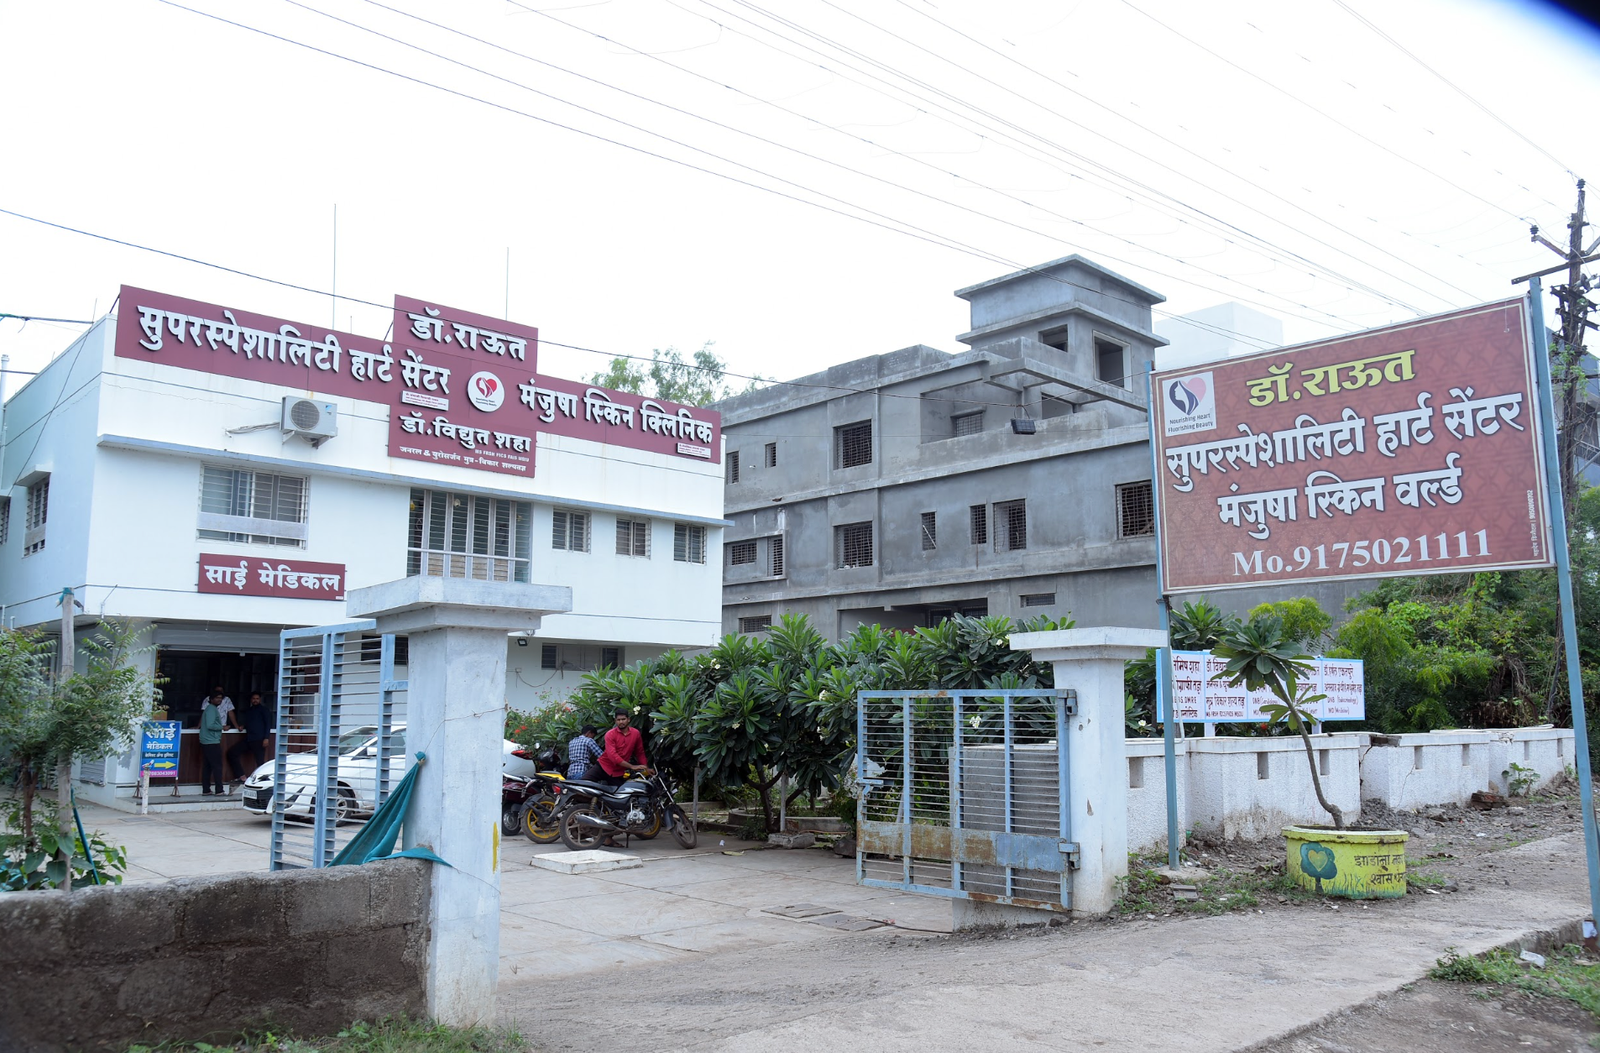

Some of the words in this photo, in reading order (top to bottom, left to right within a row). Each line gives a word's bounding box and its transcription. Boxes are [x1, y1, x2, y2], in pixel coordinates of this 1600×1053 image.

[137, 305, 342, 373] सुपरस्पेशालिटी
[348, 341, 394, 382] हार्ट
[399, 349, 451, 395] सेंटर
[518, 377, 578, 423] मंजुषा
[584, 388, 635, 429] स्किन
[640, 400, 713, 443] क्लिनिक
[1169, 415, 1196, 425] Nourishing
[1196, 421, 1213, 429] Beauty
[399, 446, 423, 455] जनरल
[423, 449, 431, 457] &
[493, 431, 531, 453] शहा
[1166, 407, 1365, 493] सुपरस्पेशालिटी
[1373, 391, 1434, 457] हार्ट
[1441, 386, 1524, 440] सेंटर
[1217, 483, 1298, 541] मंजुषा
[1305, 471, 1385, 519] स्किन
[1392, 452, 1463, 507] वर्ल्ड
[203, 560, 249, 590] साई
[257, 561, 341, 591] मेडिकल
[146, 741, 173, 750] मेडिकल
